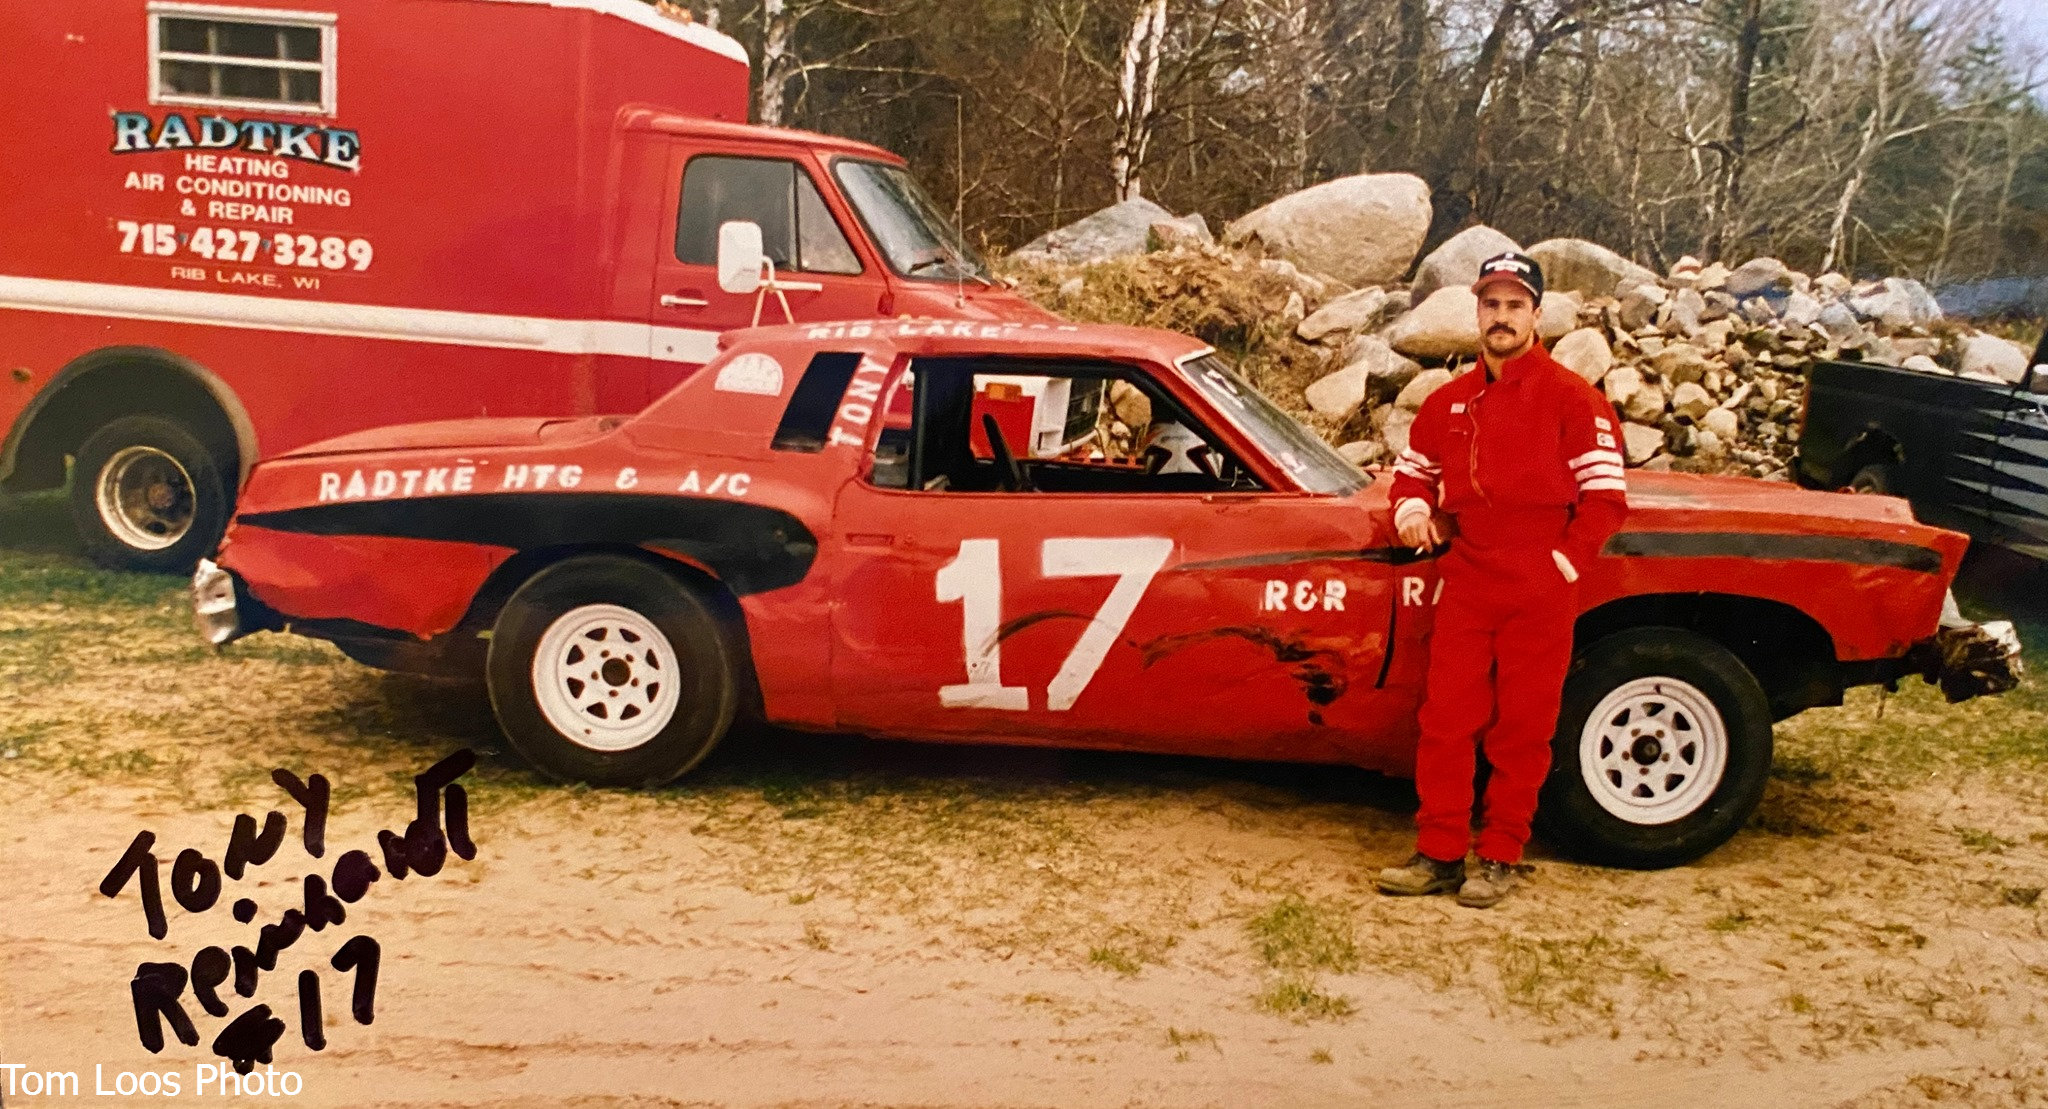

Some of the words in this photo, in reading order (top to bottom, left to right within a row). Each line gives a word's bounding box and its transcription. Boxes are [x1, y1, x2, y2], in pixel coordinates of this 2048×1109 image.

[112, 110, 361, 172] RADTKE
[185, 154, 289, 179] HEATING
[124, 171, 165, 192] AIR
[176, 176, 351, 207] CONDITIONING
[180, 199, 196, 217] &
[208, 201, 293, 225] REPAIR
[171, 266, 206, 282] RIB
[293, 277, 320, 290] WI
[830, 355, 891, 448] TONY
[318, 466, 476, 502] RADTKE
[503, 465, 583, 489] HTG
[615, 467, 639, 489] &
[678, 472, 751, 497] A/C
[1264, 580, 1346, 612] R&R
[936, 537, 1174, 711] 17
